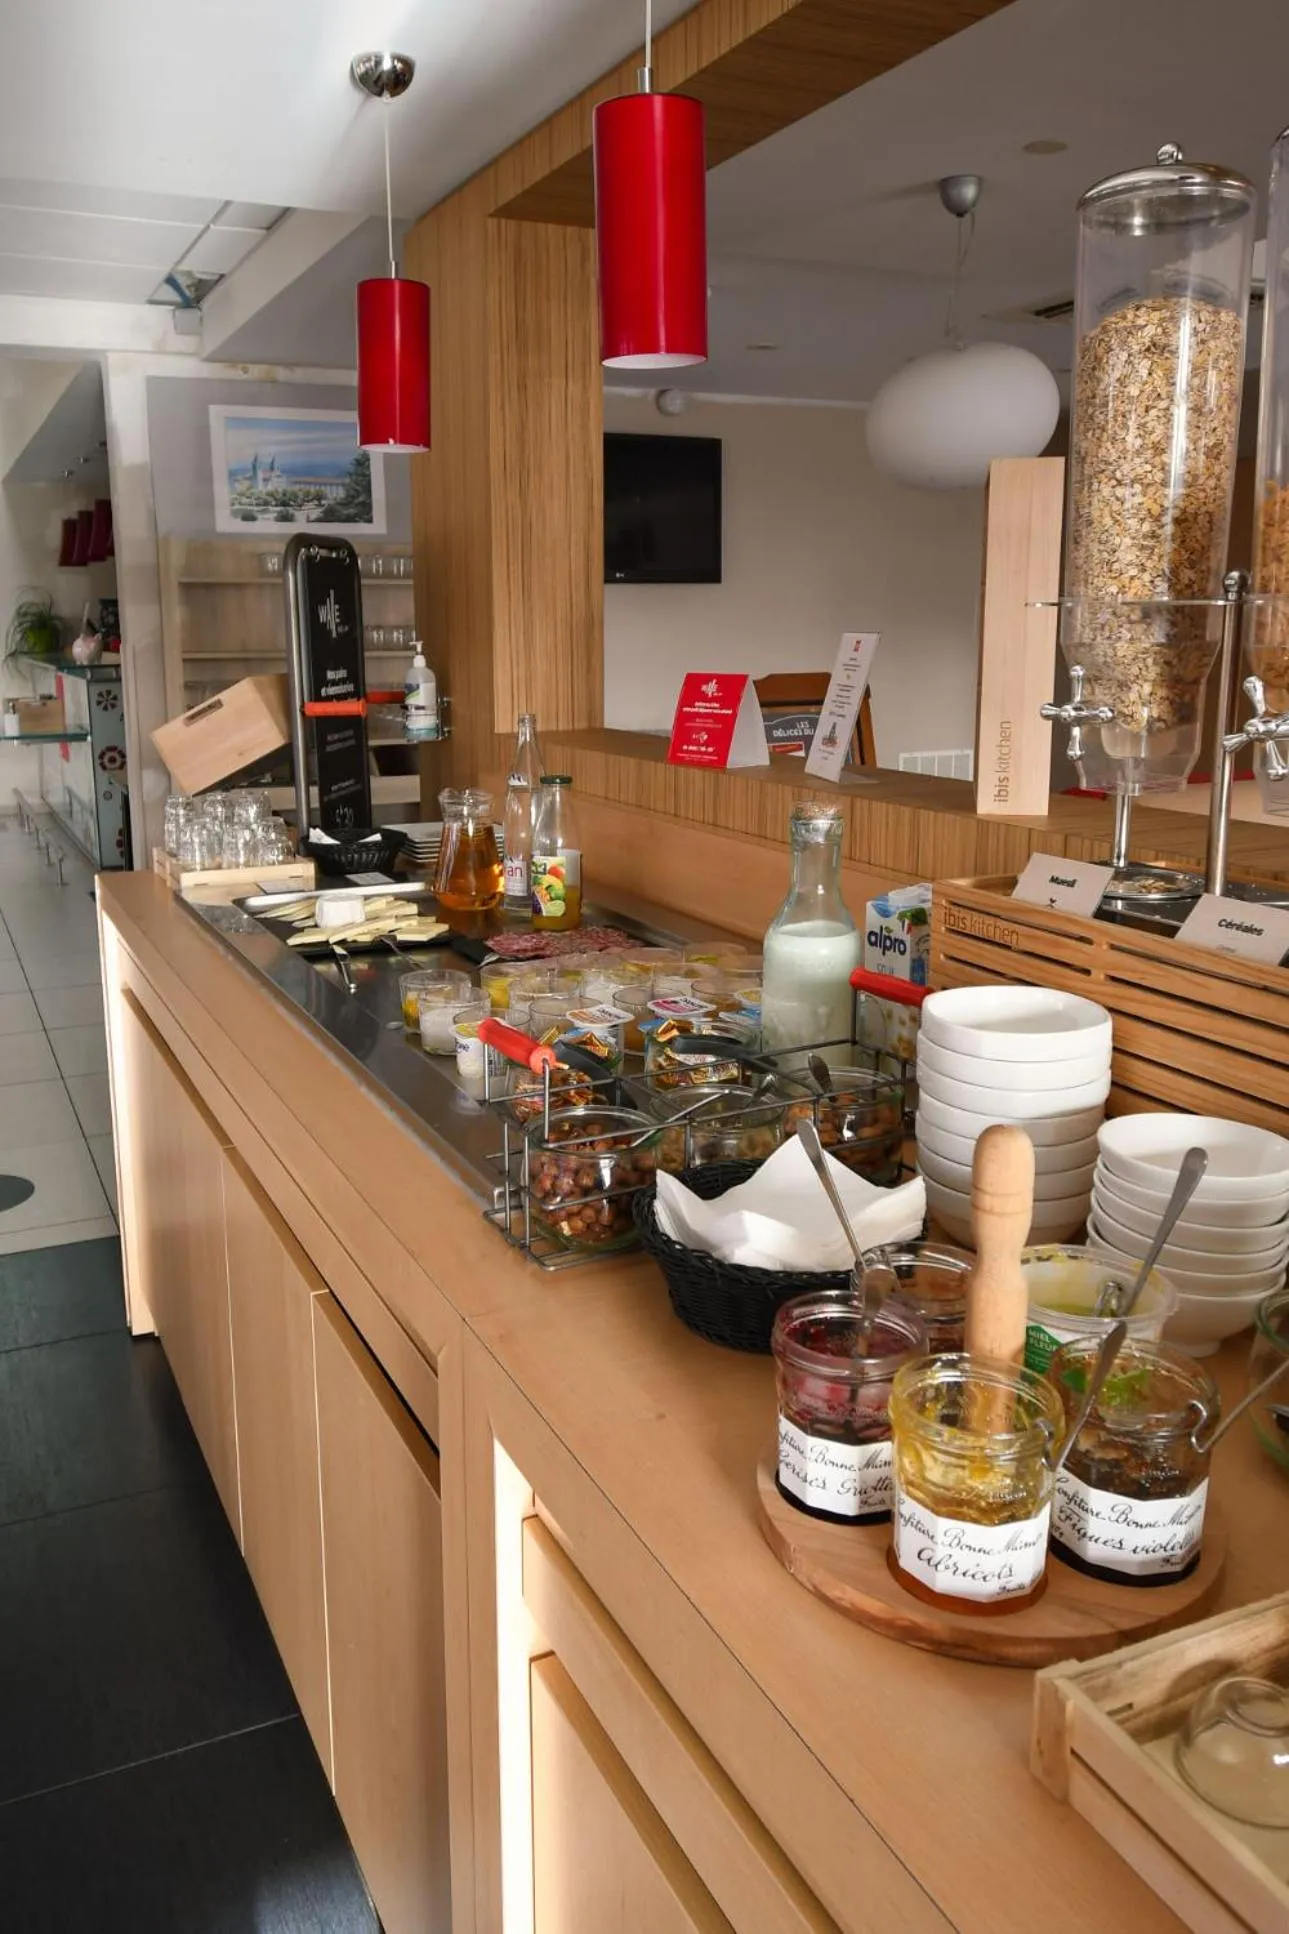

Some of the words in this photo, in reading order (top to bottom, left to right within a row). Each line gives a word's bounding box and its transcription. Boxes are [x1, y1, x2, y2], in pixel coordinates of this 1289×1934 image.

[995, 720, 1012, 774] kitchen
[993, 775, 1010, 803] ibis
[867, 925, 907, 956] alpro
[943, 906, 968, 931] ibis
[969, 915, 1021, 947] kitchen
[1217, 917, 1265, 937] Céréales
[1106, 1502, 1162, 1529] Bonne
[942, 1527, 995, 1556] Bonne
[917, 1547, 1014, 1583] Abricots
